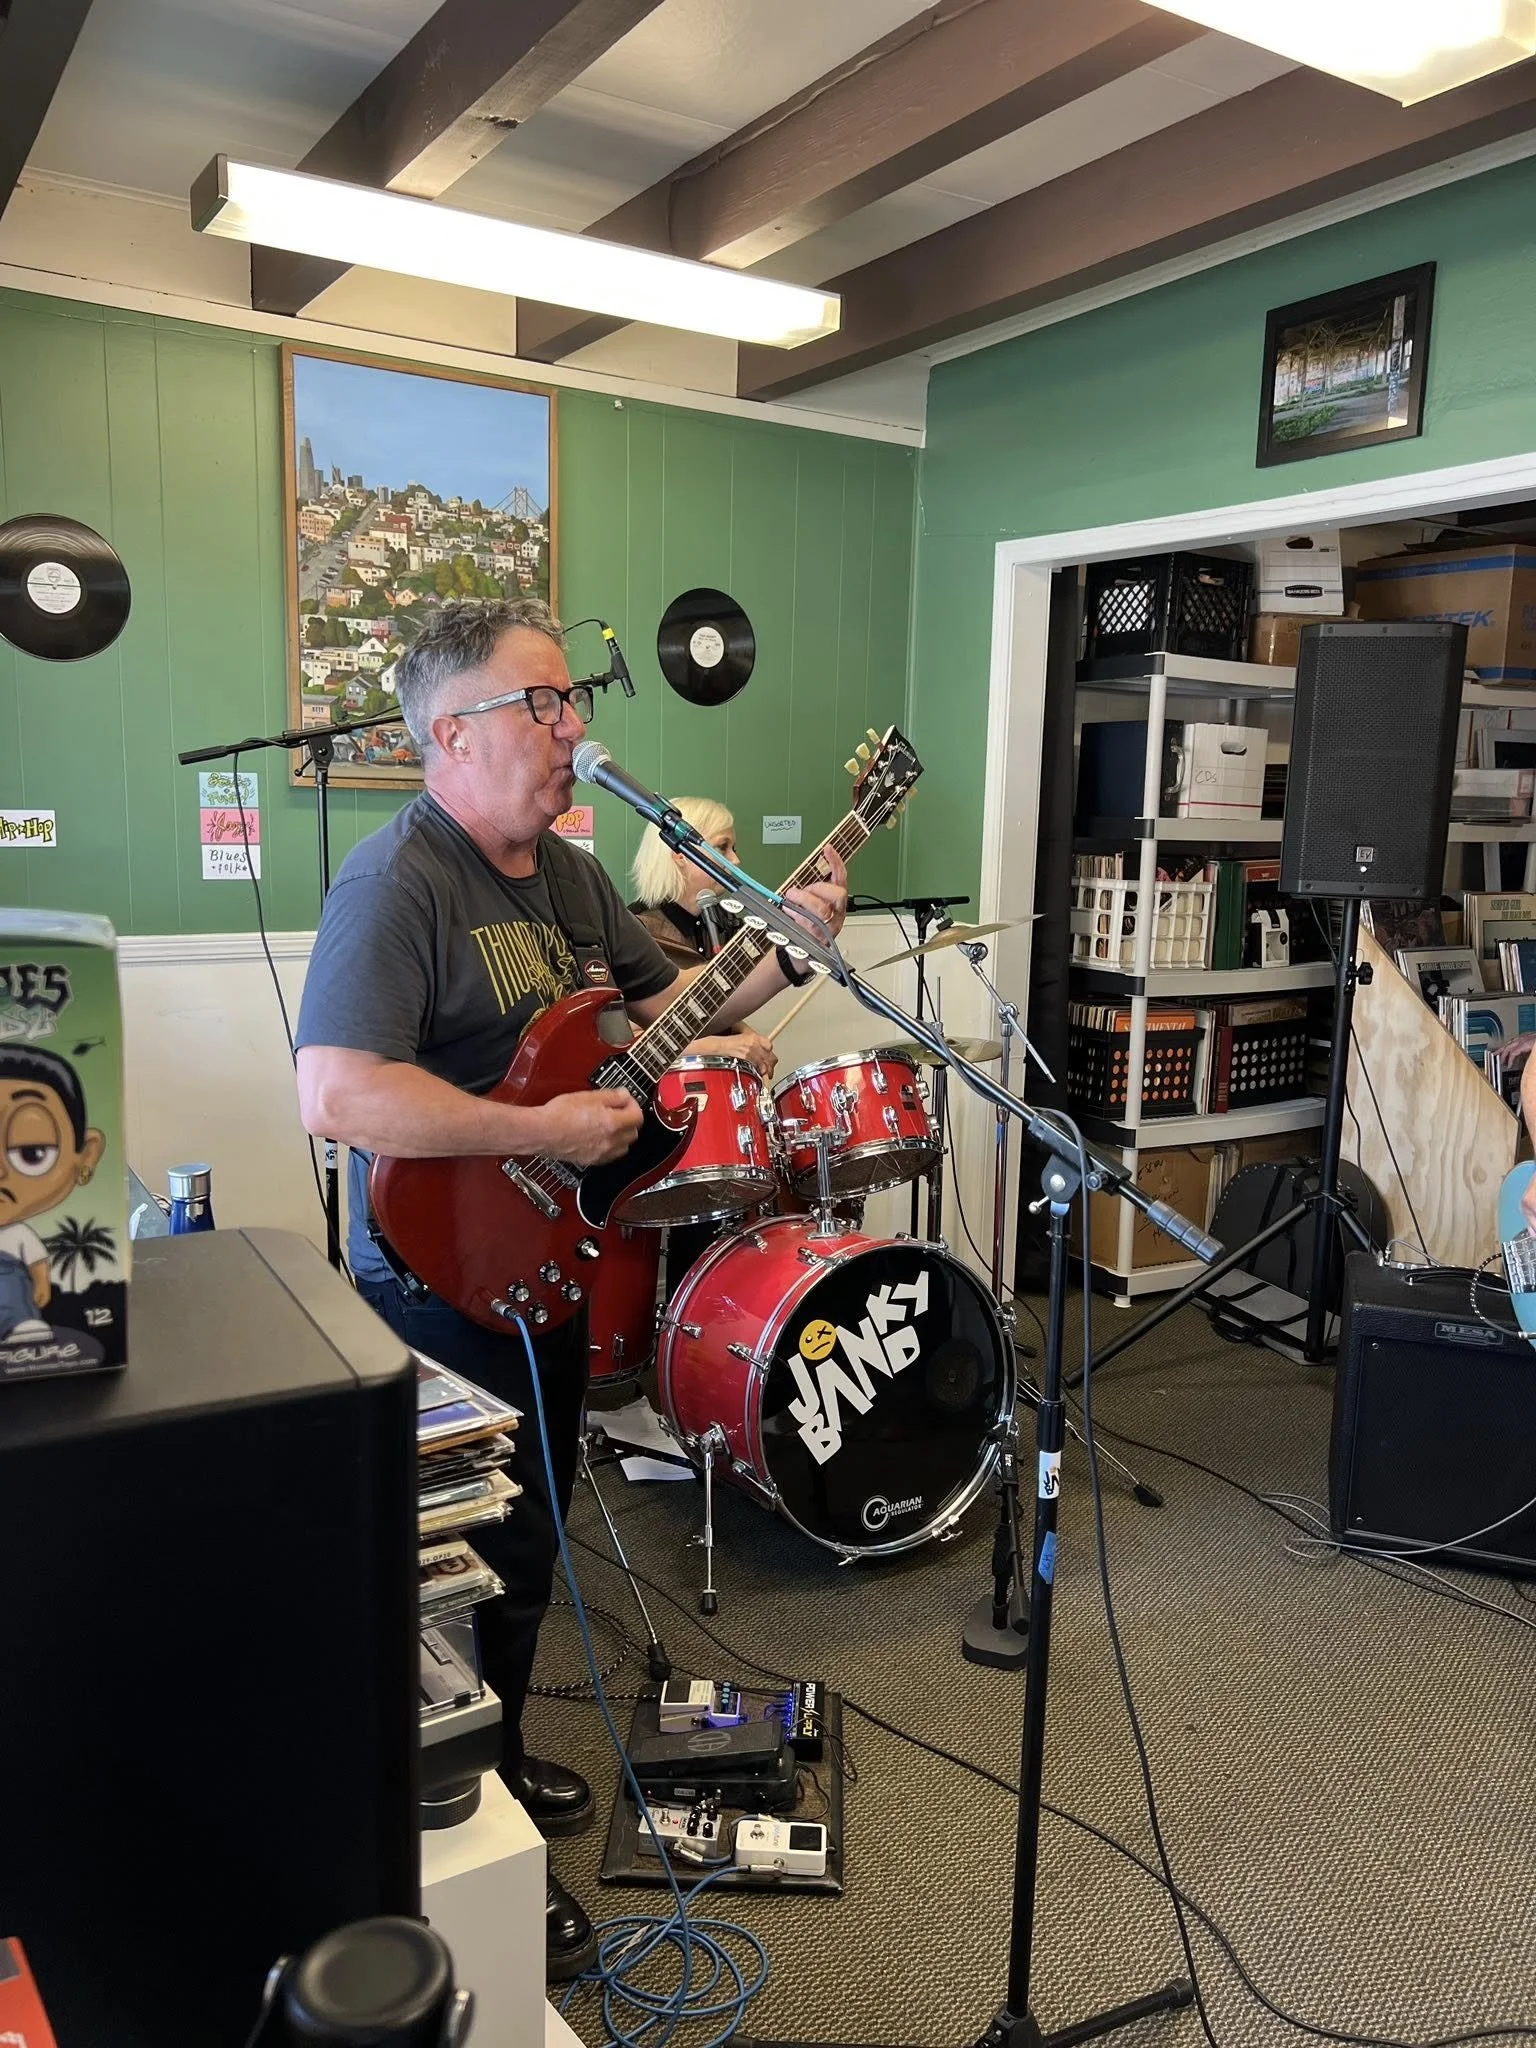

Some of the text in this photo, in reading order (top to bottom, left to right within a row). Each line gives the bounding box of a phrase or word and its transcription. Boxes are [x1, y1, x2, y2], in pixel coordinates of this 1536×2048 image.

[556, 810, 584, 832] POP
[85, 1309, 113, 1326] 12
[1441, 1325, 1497, 1338] MESA
[788, 1270, 929, 1432] JANKY
[797, 1317, 921, 1466] BAND
[872, 1495, 922, 1517] AQUARIAN
[804, 1682, 817, 1713] POWER
